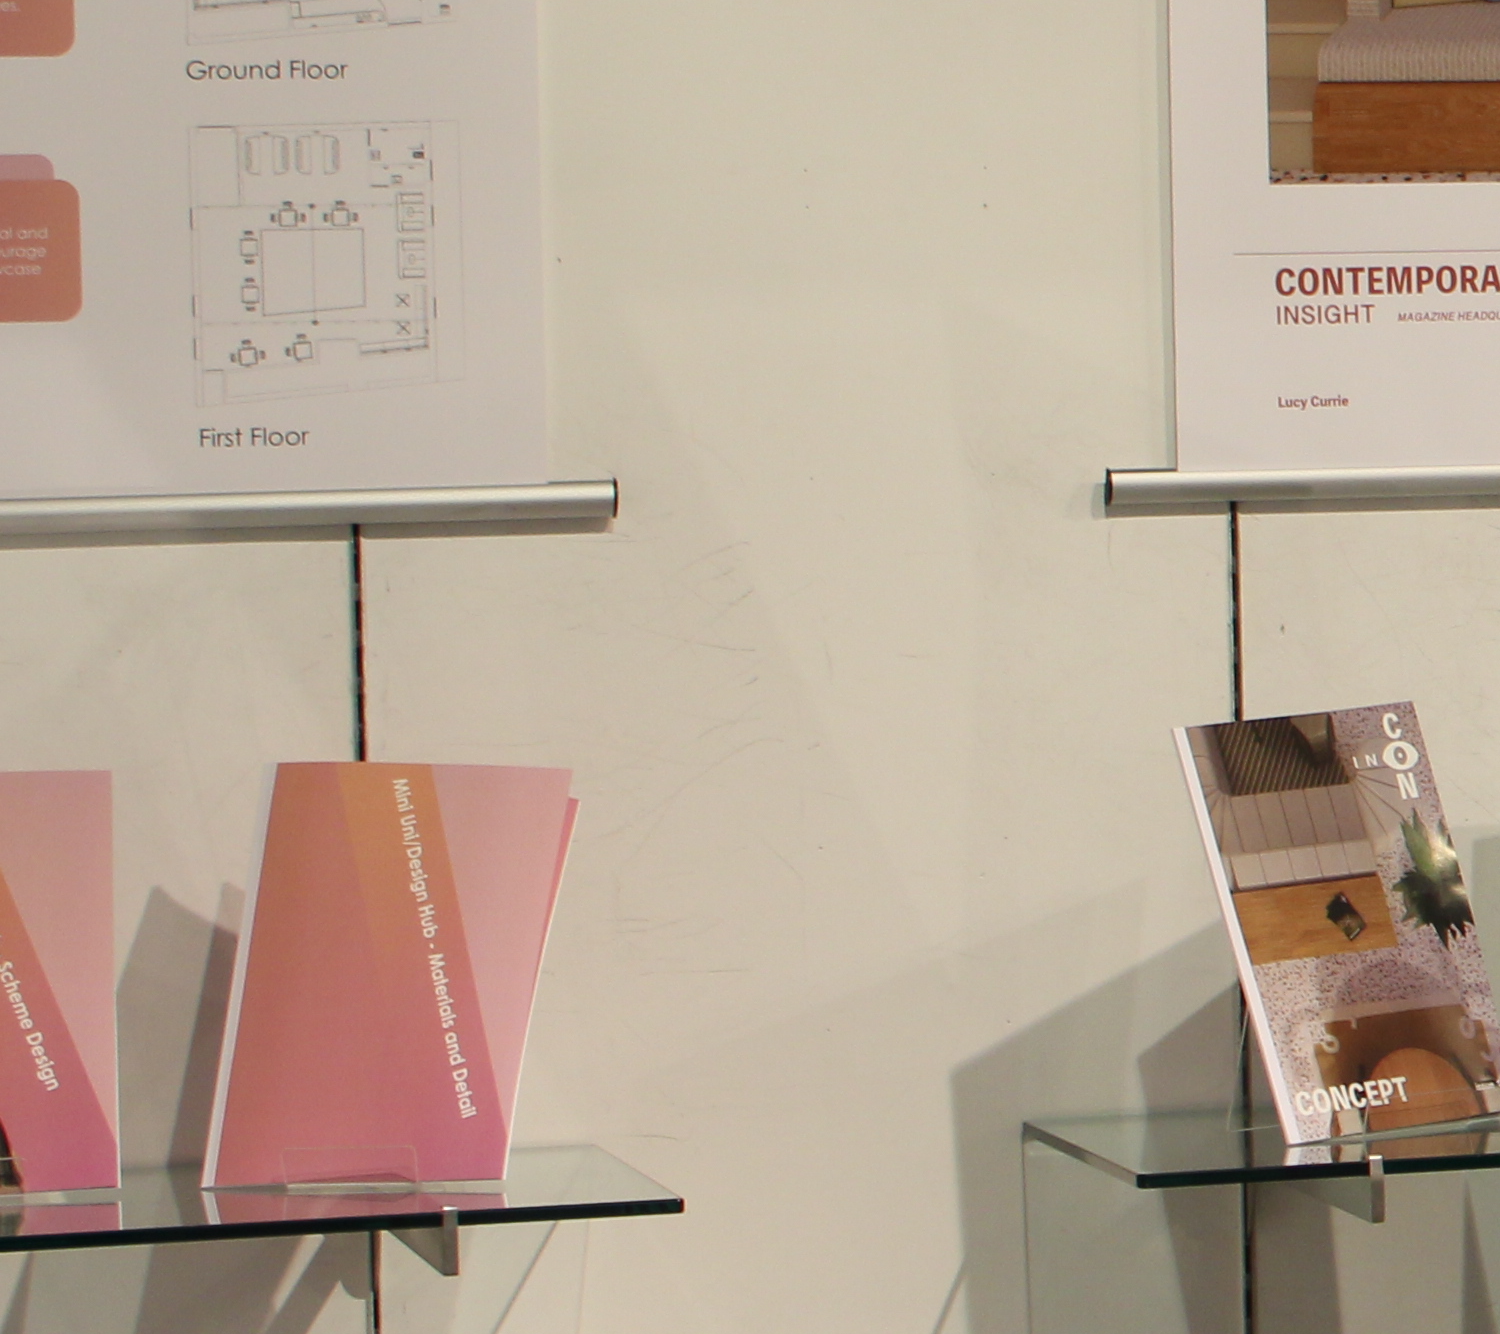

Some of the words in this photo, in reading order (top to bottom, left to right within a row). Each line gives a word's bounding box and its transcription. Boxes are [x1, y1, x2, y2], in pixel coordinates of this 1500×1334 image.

[186, 58, 281, 81] Ground
[289, 59, 348, 80] Floor
[1276, 304, 1375, 325] INSIGHT
[1397, 310, 1455, 323] MAGAZINE
[1278, 396, 1308, 410] Lucy
[1310, 394, 1349, 408] Currie
[199, 427, 243, 448] First
[250, 427, 310, 447] Floor
[392, 779, 415, 812] Mini
[400, 815, 428, 902] Uni/Design
[418, 904, 438, 938] Hub
[428, 953, 457, 1029] Materials
[26, 1032, 60, 1091] Design
[445, 1032, 466, 1066] and
[452, 1068, 477, 1119] Detail
[1296, 1076, 1410, 1116] CONCEPT
